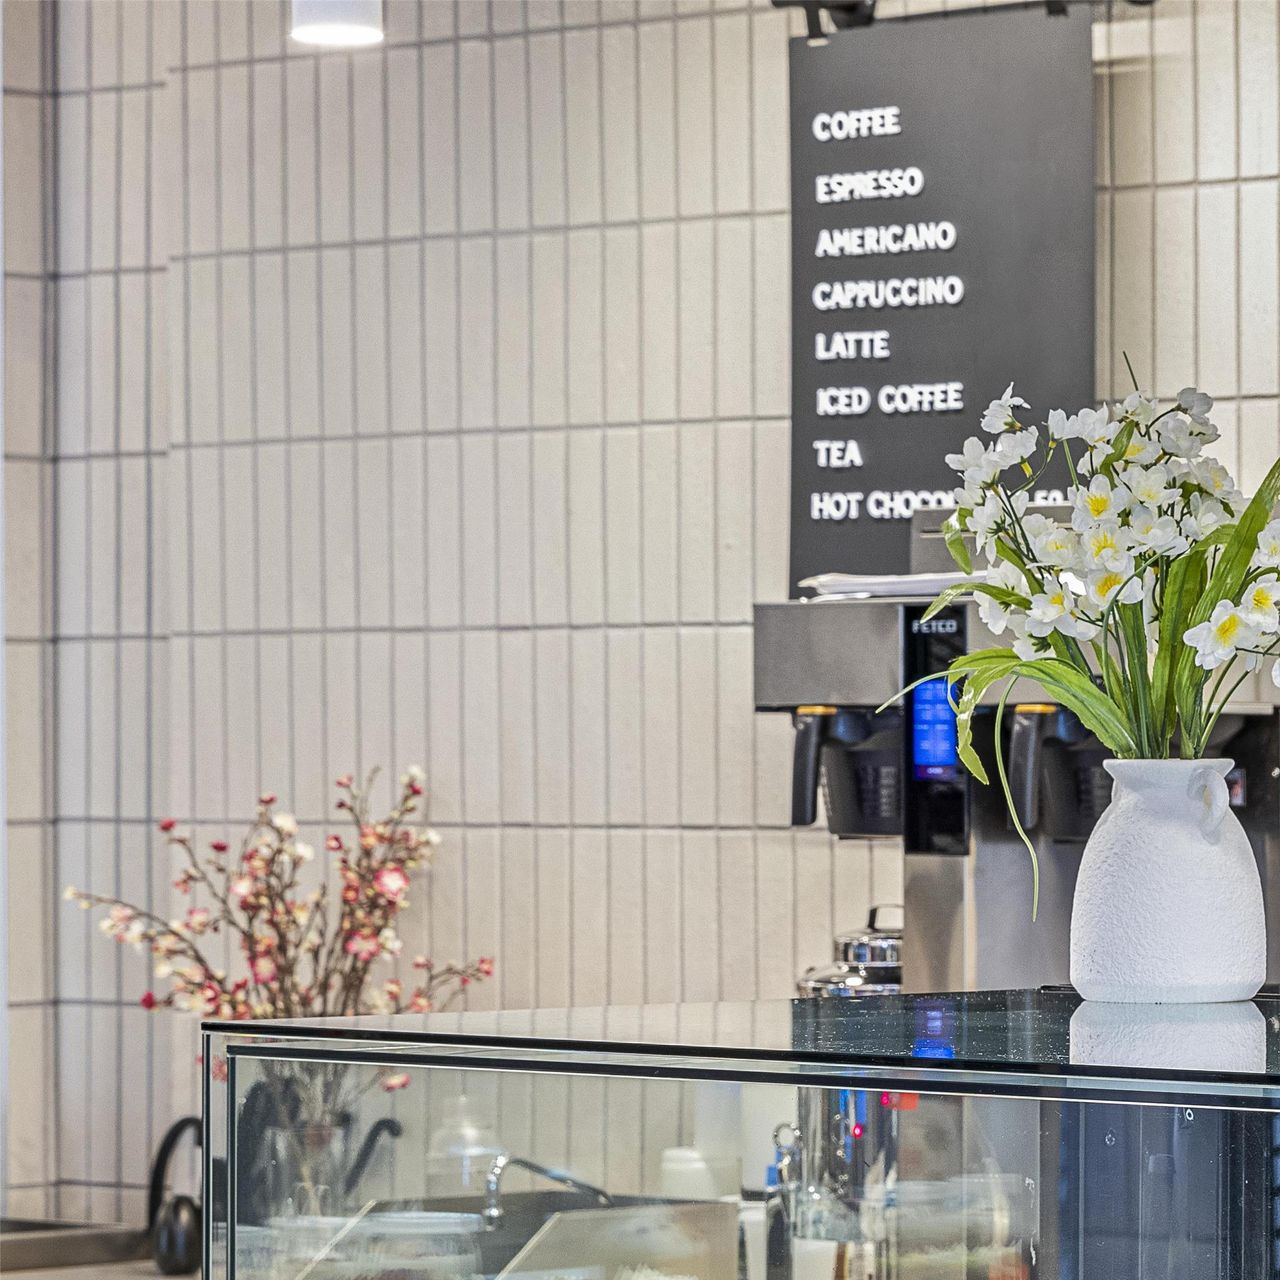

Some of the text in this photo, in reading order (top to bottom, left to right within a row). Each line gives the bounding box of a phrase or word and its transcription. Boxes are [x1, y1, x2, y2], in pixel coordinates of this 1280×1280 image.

[812, 106, 901, 142] COFFEE
[815, 167, 924, 203] ESPRESSO
[815, 221, 956, 257] AMERICANO
[812, 276, 964, 311] CAPPUCCINO
[815, 330, 890, 360] LATTE
[816, 382, 963, 416] ICED COFFEE
[813, 440, 862, 469] TEA
[811, 492, 863, 519] HOT
[912, 619, 958, 634] FETCO
